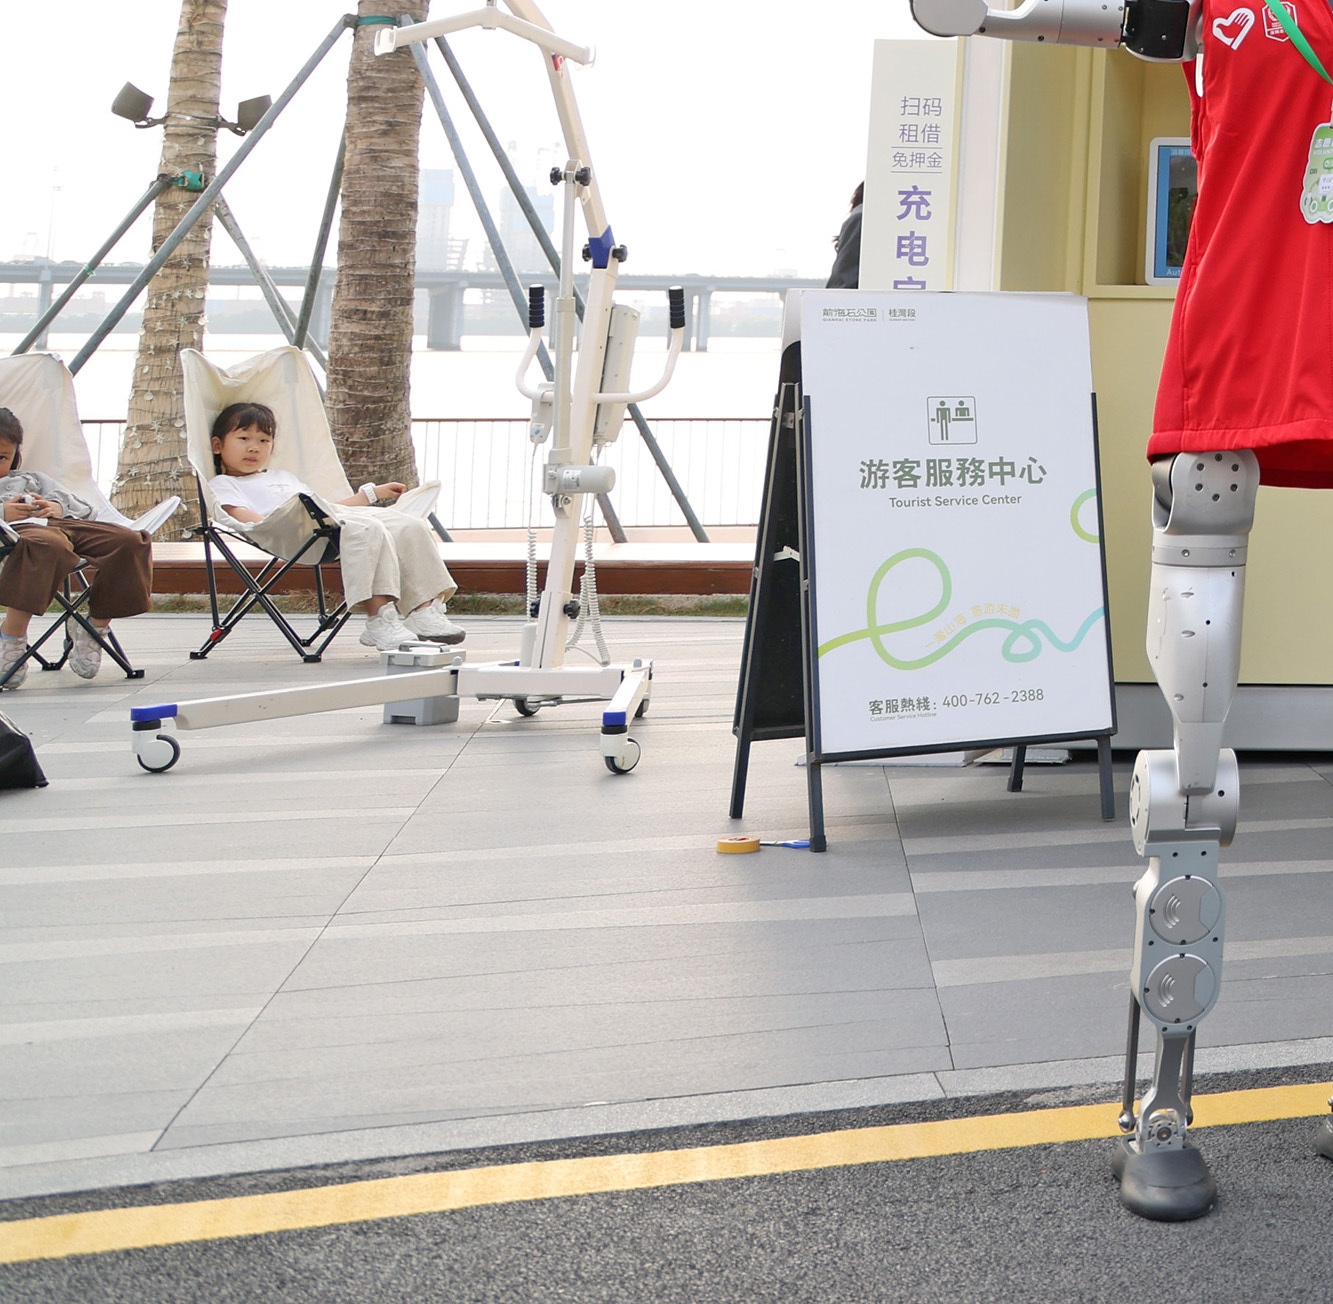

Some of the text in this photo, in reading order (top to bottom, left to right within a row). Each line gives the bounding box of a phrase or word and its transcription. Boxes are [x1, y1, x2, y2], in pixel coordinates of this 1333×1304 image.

[900, 96, 942, 117] 扫码
[898, 123, 941, 144] 租借
[891, 151, 943, 169] 免押金
[858, 456, 1048, 490] 游客服務中心
[889, 494, 1022, 508] Tourist Service Center
